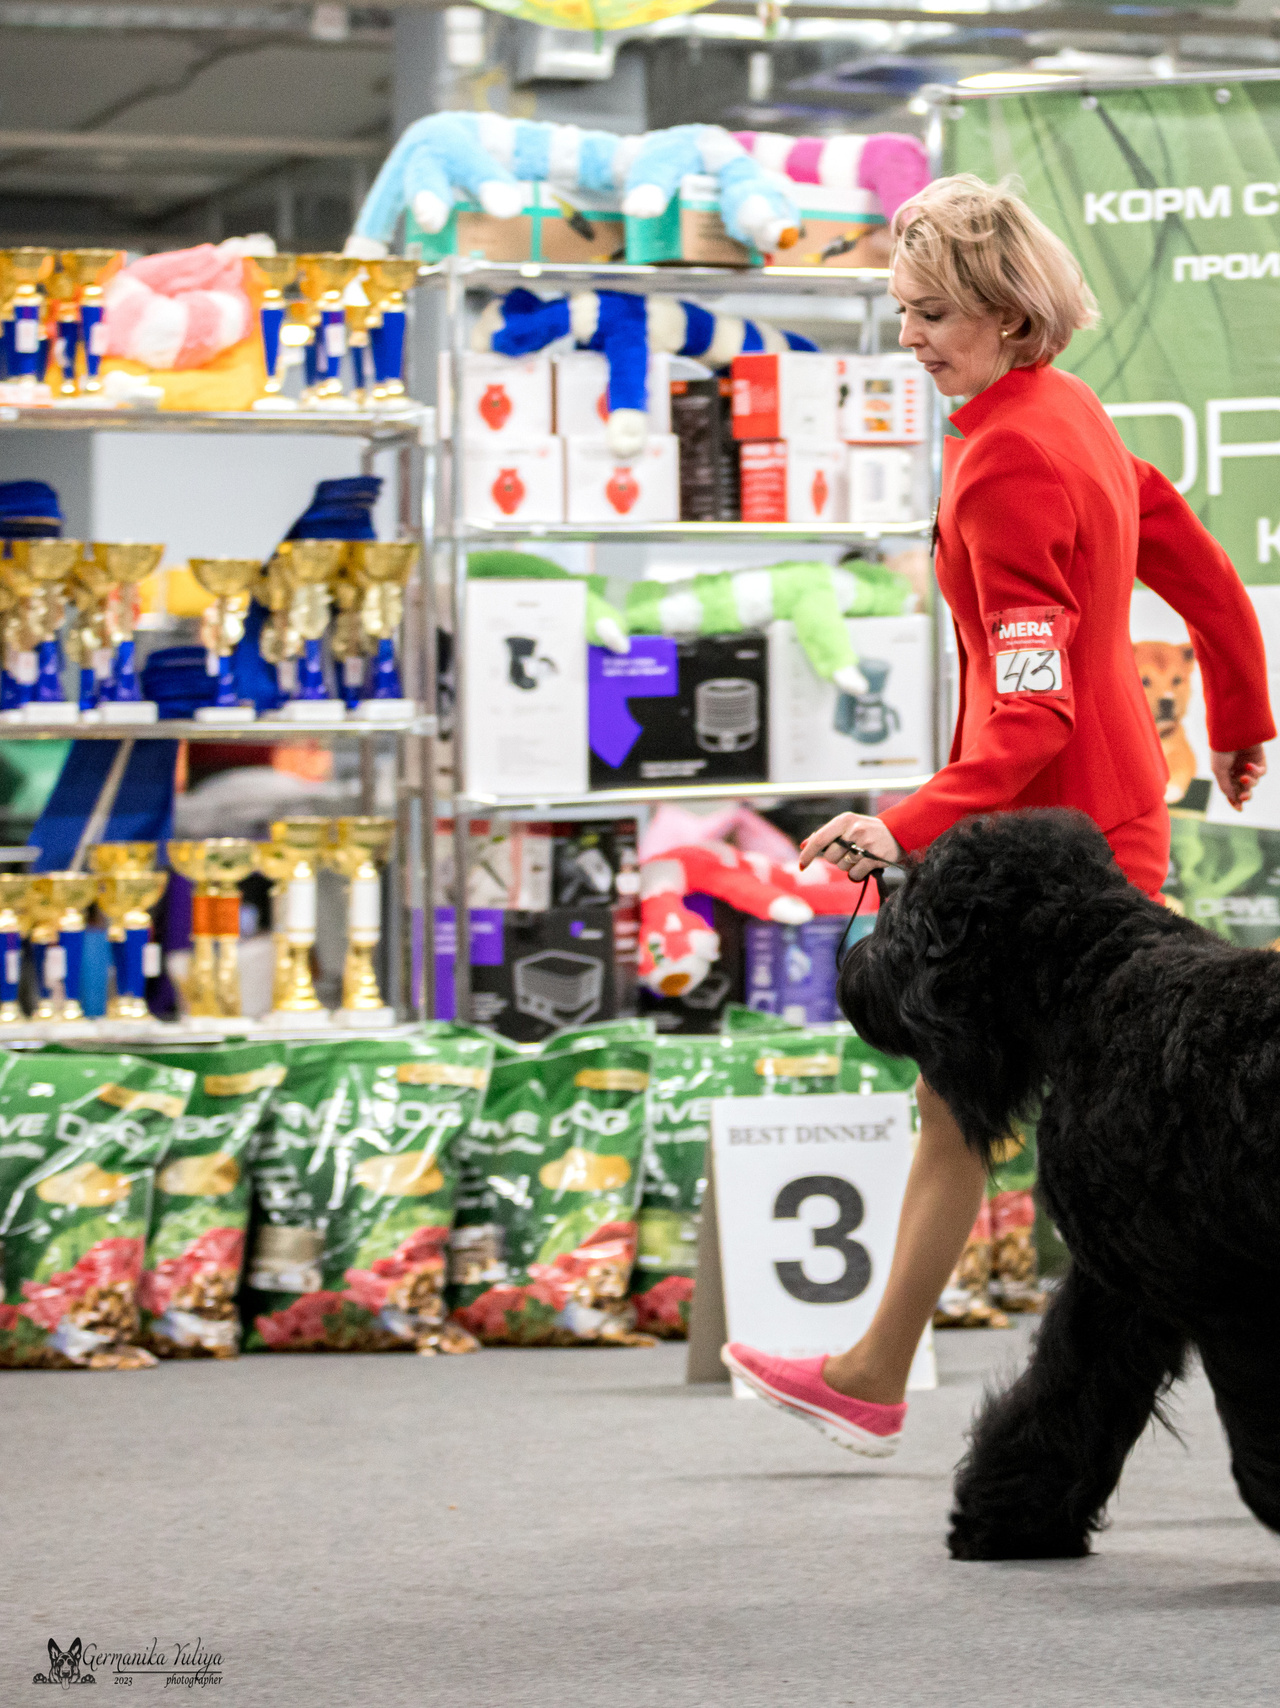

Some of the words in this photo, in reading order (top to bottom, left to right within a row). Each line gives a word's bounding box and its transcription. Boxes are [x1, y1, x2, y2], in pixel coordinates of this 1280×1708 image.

[1084, 186, 1231, 225] КОРМ
[998, 621, 1053, 639] MERA
[1003, 650, 1056, 693] 43
[728, 1126, 786, 1146] BEST
[796, 1120, 890, 1144] DINNER
[773, 1174, 873, 1304] 3
